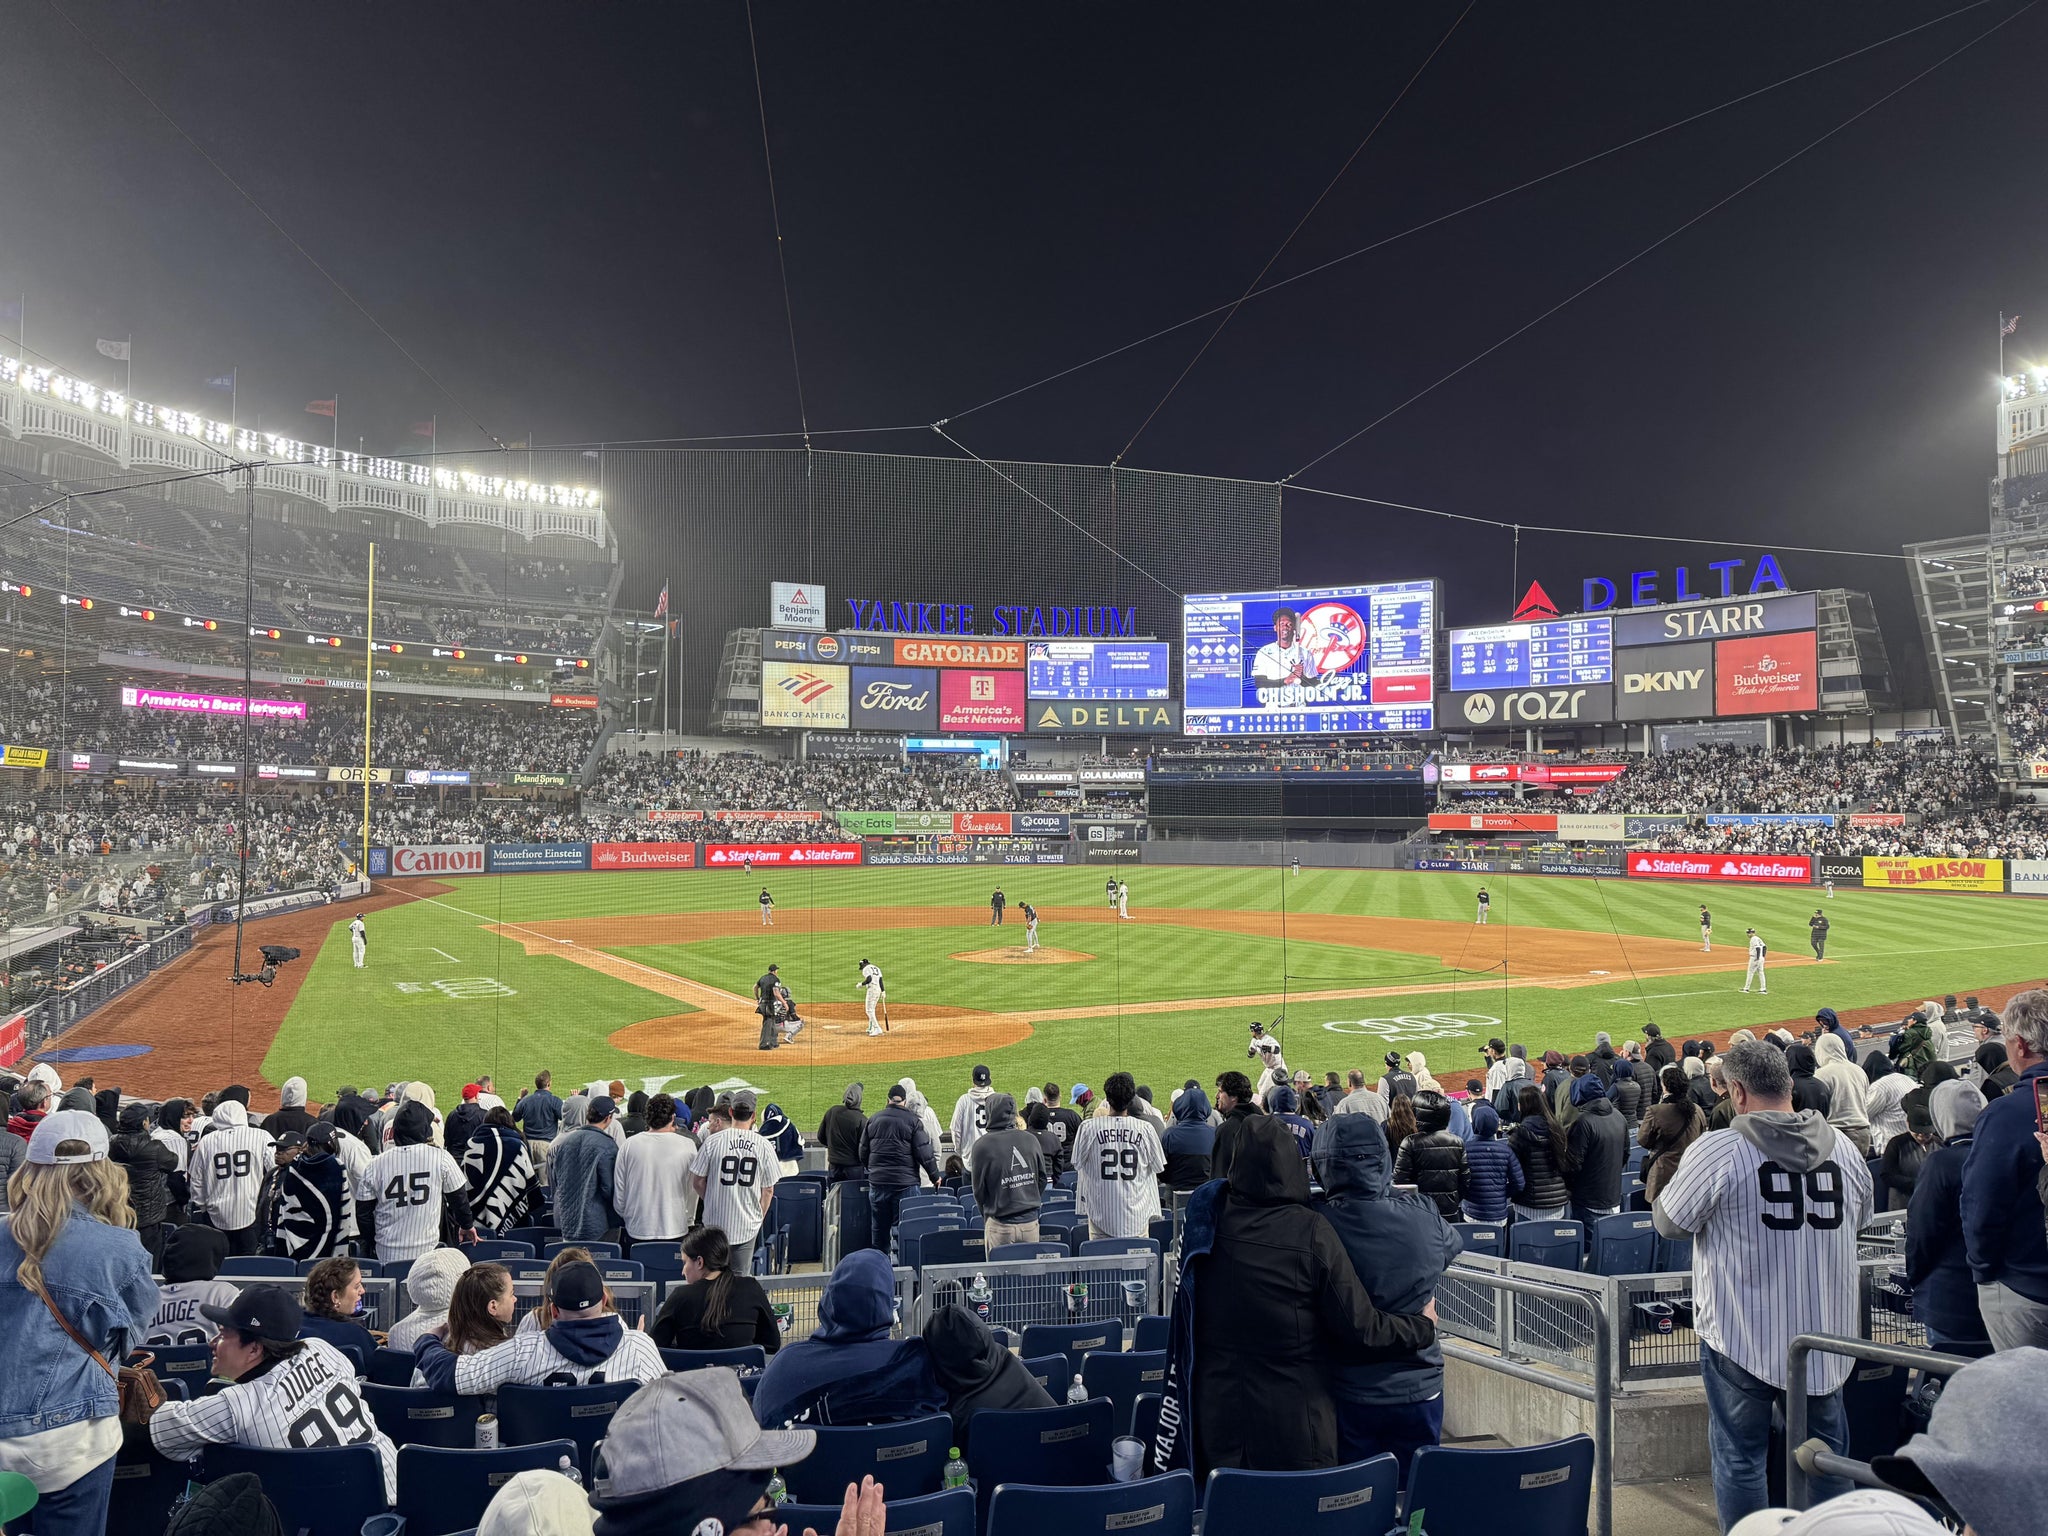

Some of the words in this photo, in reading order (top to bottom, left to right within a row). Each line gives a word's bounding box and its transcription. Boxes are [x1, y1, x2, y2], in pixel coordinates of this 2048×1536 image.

[1583, 554, 1787, 611] DELTA
[779, 605, 820, 616] Benjamin
[845, 598, 975, 636] YANKEE
[993, 605, 1137, 637] STADIUM
[784, 613, 813, 623] Moore
[1664, 604, 1765, 639] STARR
[775, 641, 806, 650] PEPSI
[850, 645, 880, 655] PEPSI
[902, 644, 1019, 664] GATORADE
[2006, 654, 2020, 662] 2021
[2026, 652, 2039, 660] MLS
[354, 681, 368, 690] CLU
[1316, 669, 1352, 690] Jazz
[1352, 672, 1368, 685] 13
[1624, 669, 1704, 694] DKNY
[1734, 672, 1801, 686] Budweiser
[860, 681, 929, 711] Ford
[1256, 685, 1338, 704] CHISHOLM
[1341, 685, 1368, 701] JR.
[1732, 687, 1758, 696] Made
[1758, 686, 1766, 695] of
[1765, 684, 1800, 694] America
[140, 693, 209, 709] America's
[212, 701, 242, 712] Best
[565, 696, 596, 706] Budweiser
[1504, 690, 1586, 720] razr
[764, 710, 789, 718] BANK
[806, 712, 846, 720] AMERICA
[952, 706, 1012, 714] America's
[1072, 708, 1171, 726] DELTA
[942, 715, 968, 724] Best
[971, 715, 1022, 725] Network
[340, 768, 378, 780] ORS
[514, 774, 538, 783] Poland
[540, 774, 564, 786] Spring
[866, 819, 892, 828] Eats
[1033, 817, 1060, 827] coupa
[1650, 824, 1683, 832] CLEAR
[1852, 817, 1882, 825] Reebok
[1090, 830, 1102, 838] GS
[394, 849, 482, 872] Canon
[494, 850, 542, 859] Montefiore
[545, 848, 582, 858] Einstein
[621, 851, 690, 863] Budweiser
[870, 856, 900, 864] StubHub
[903, 855, 934, 863] StubHub
[936, 855, 968, 863] StubHub
[1461, 862, 1488, 870] STARR
[1542, 865, 1568, 873] StubHub
[1822, 866, 1861, 875] LEGORA
[1877, 860, 1893, 868] WHO
[1895, 860, 1909, 868] BUT
[1918, 861, 1986, 880] MASON
[2015, 873, 2048, 881] BANK
[1096, 1129, 1142, 1146] URSHELA
[729, 1140, 756, 1152] JUDGE
[214, 1150, 251, 1178] 99
[720, 1155, 757, 1187] 99
[1101, 1149, 1138, 1180] 29
[385, 1172, 430, 1208] 45
[473, 1146, 535, 1230] ANKE
[1757, 1160, 1844, 1230] 99
[279, 1352, 334, 1412] JUDGE
[287, 1381, 374, 1449] 99
[1154, 1396, 1180, 1472] MAJOR
